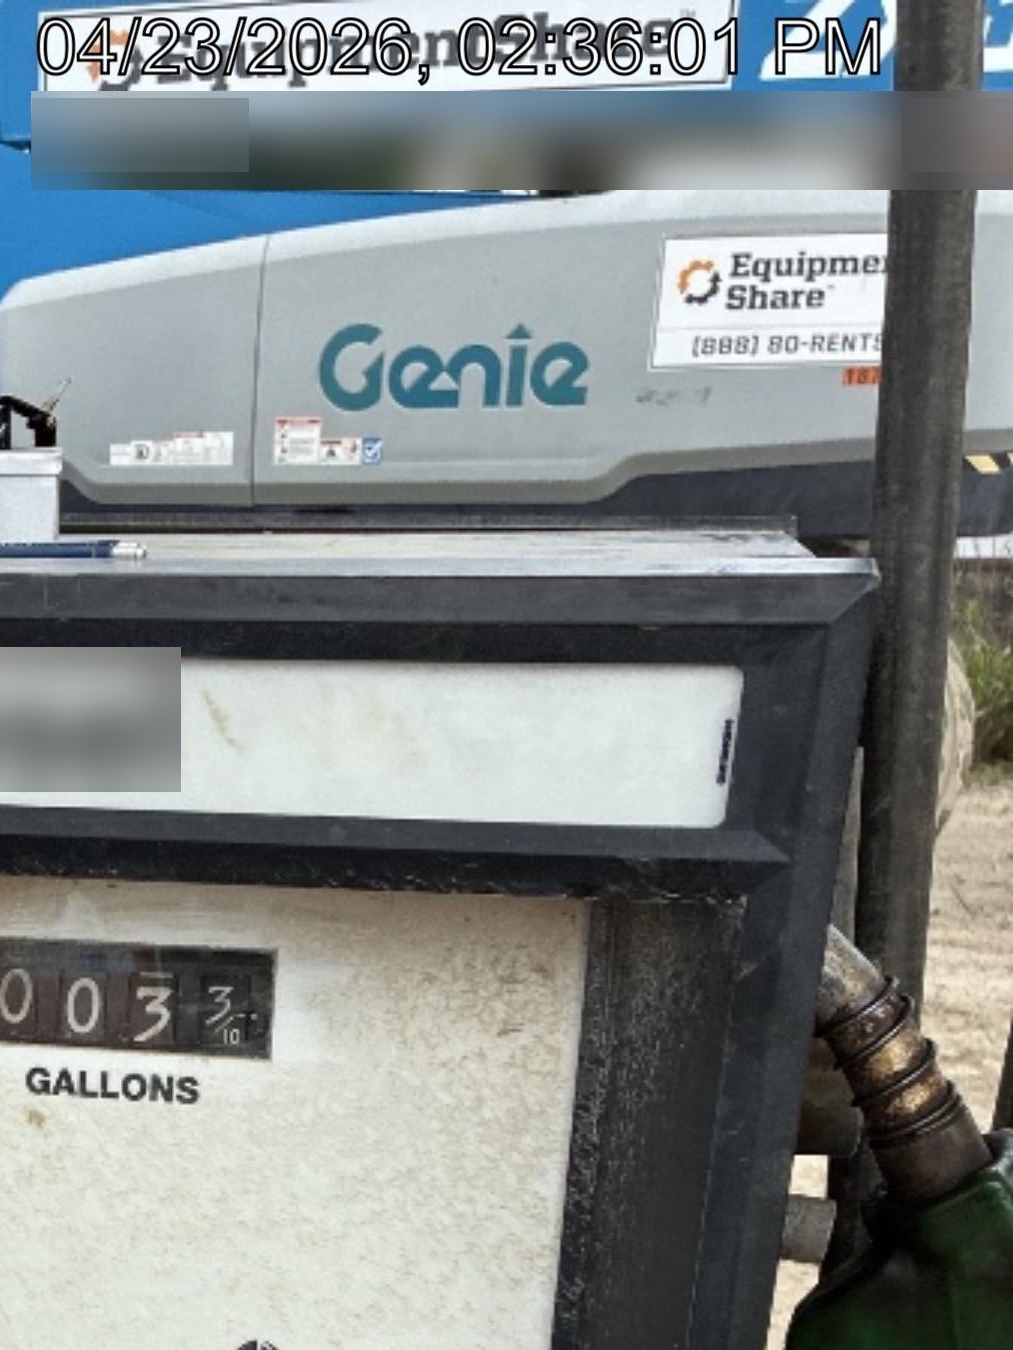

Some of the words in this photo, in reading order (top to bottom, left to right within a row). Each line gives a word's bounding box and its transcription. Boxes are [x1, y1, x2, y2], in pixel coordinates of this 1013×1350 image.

[725, 285, 825, 310] Share
[319, 322, 590, 412] Genie
[25, 1067, 200, 1104] GALLONS
